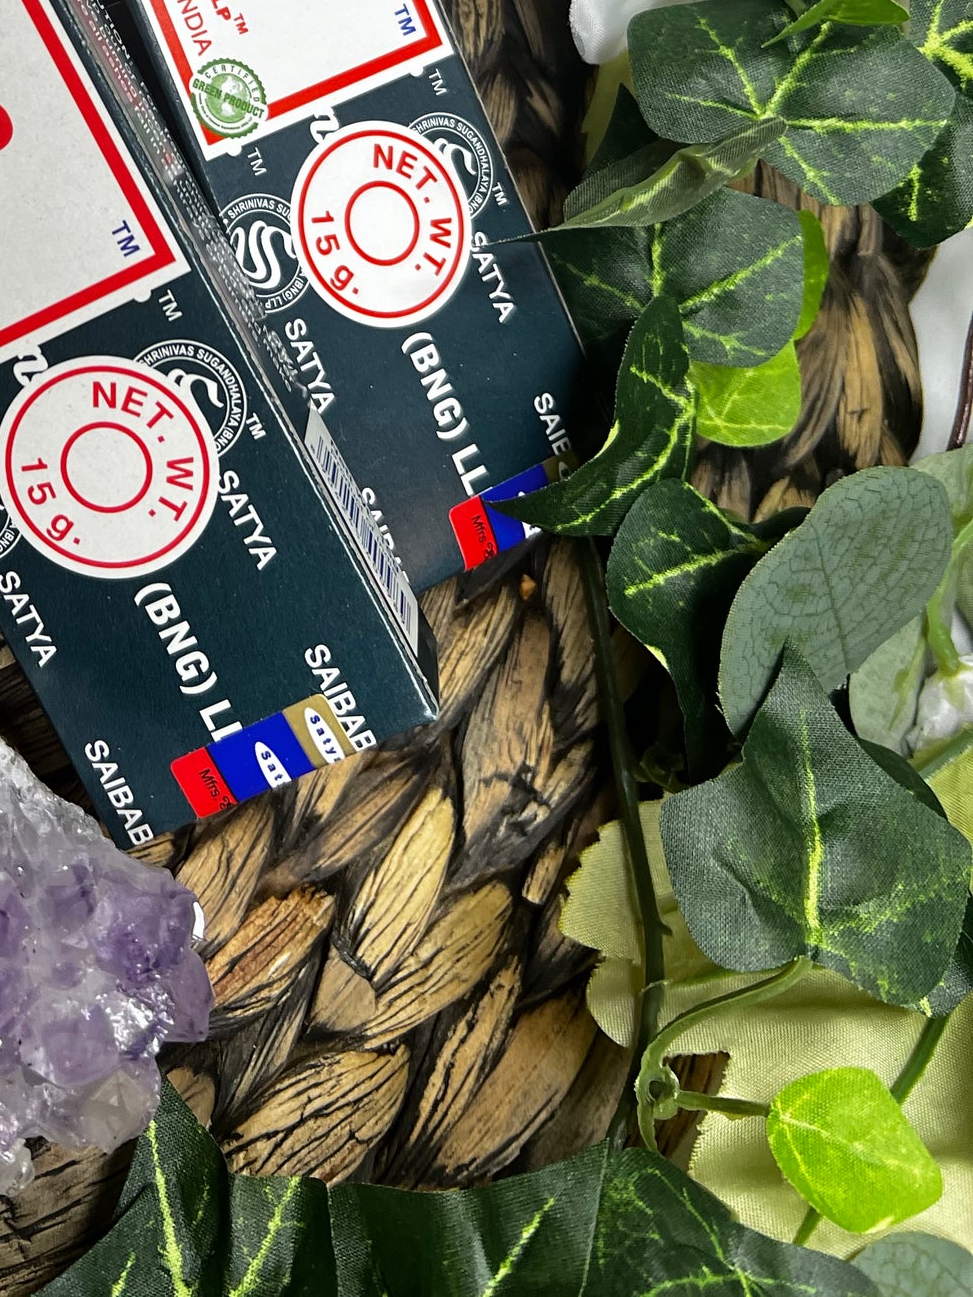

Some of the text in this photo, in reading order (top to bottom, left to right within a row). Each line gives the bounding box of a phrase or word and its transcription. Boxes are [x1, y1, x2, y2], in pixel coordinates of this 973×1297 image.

[394, 3, 416, 36] TM
[192, 78, 222, 100] GREEN
[223, 92, 265, 119] PRODUCT
[205, 64, 260, 102] CERTIFIED
[457, 122, 490, 193] SUGANDHALAYA
[111, 219, 140, 258] TM
[228, 198, 275, 219] SHRINIVAS
[373, 143, 454, 276] NET. WT.
[471, 231, 518, 324] SATYA
[197, 349, 242, 426] SUGANDHALAYA
[284, 318, 336, 416] SATYA
[92, 381, 195, 522] NET. WT.
[401, 332, 493, 497] (BNG) LL
[218, 469, 277, 571] SATYA
[134, 582, 218, 695] (BNG)
